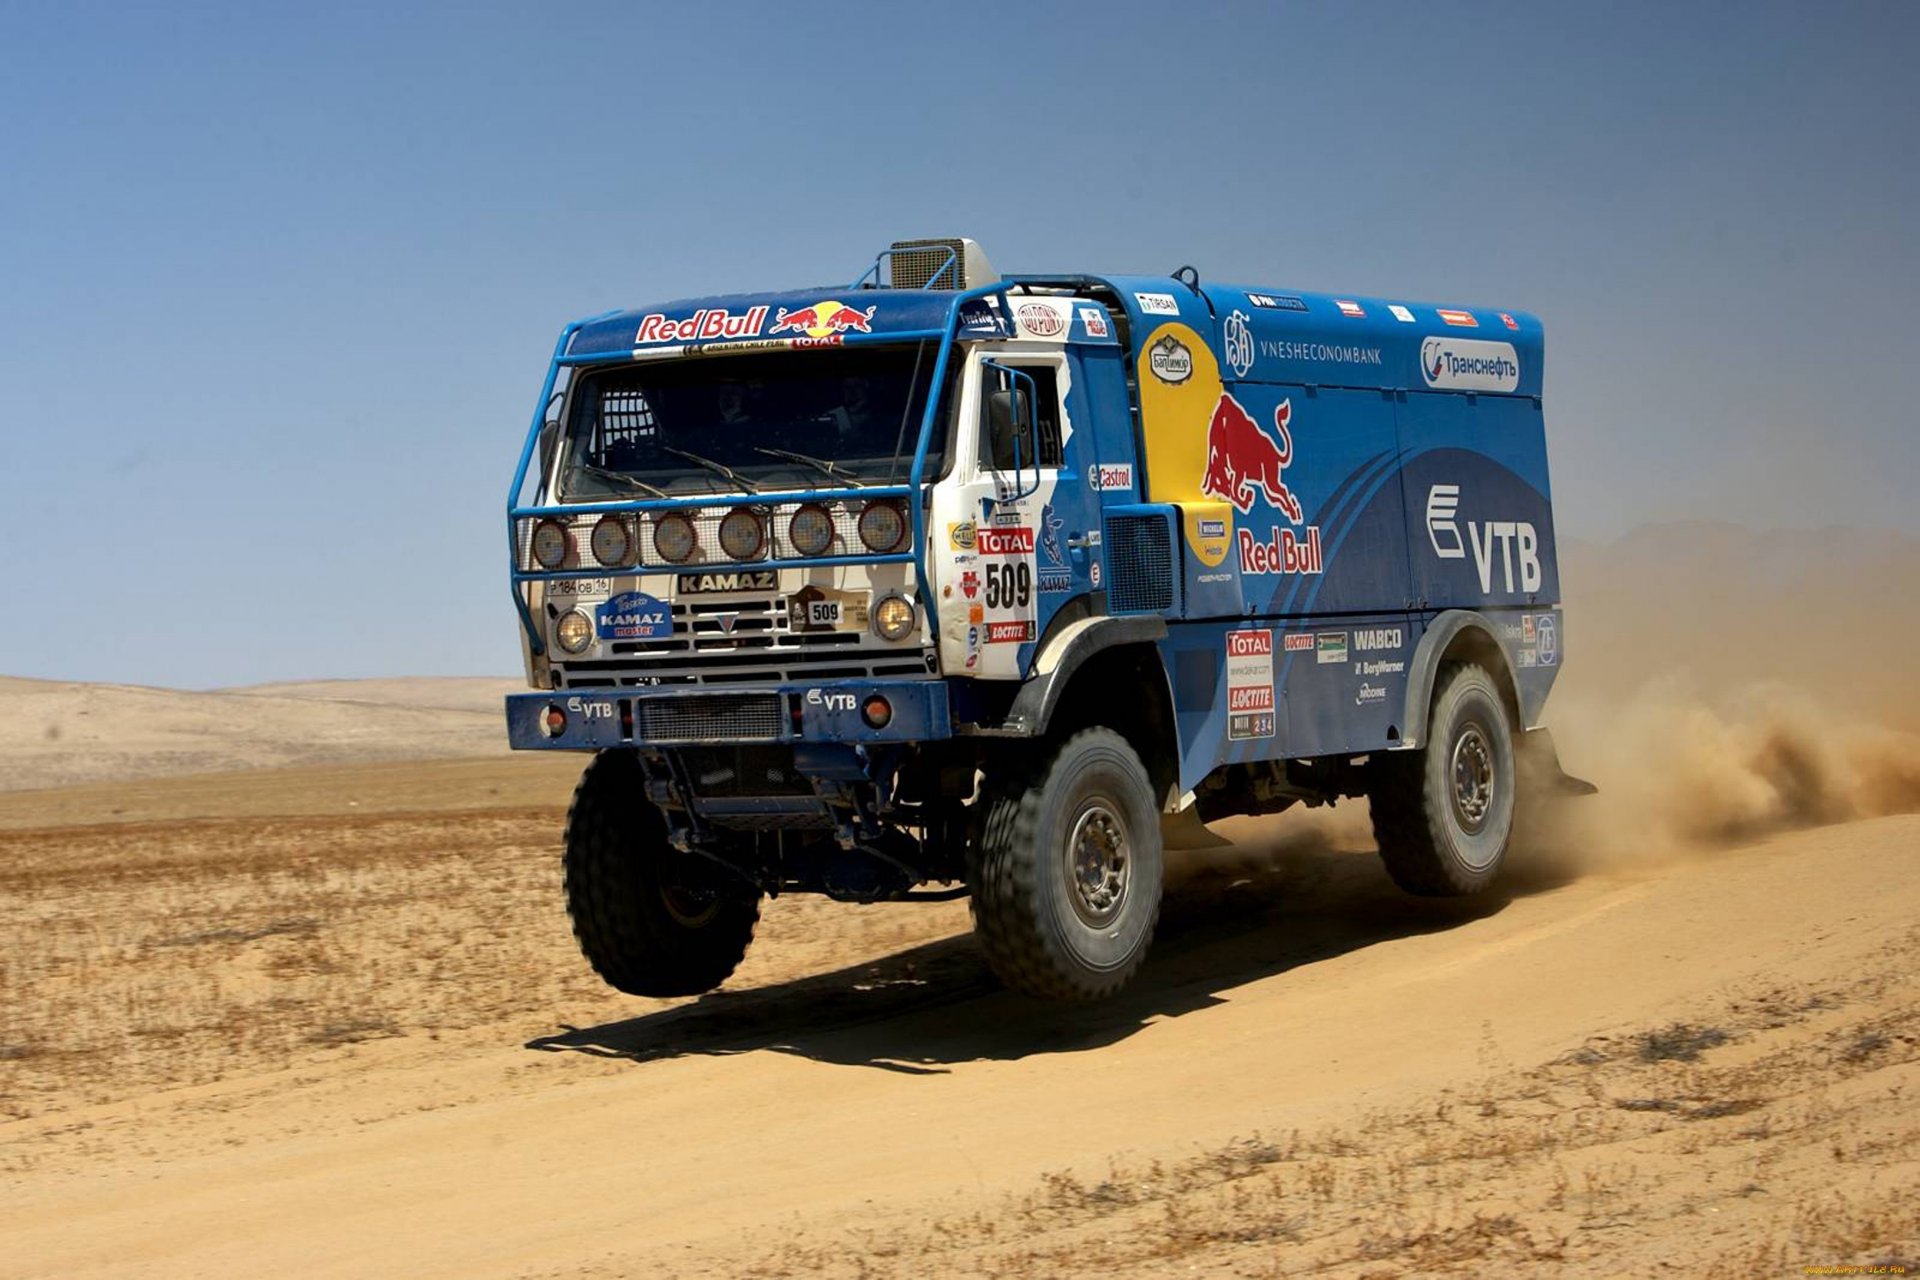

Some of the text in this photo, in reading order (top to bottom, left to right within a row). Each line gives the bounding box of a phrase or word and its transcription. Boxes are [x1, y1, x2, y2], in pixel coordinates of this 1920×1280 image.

[794, 336, 838, 348] TOTAL
[1260, 340, 1382, 365] VNESHECONOMBANK
[1443, 351, 1517, 378] Транснефть
[1100, 467, 1130, 487] Castrol
[978, 530, 1033, 552] TOTAL
[1467, 521, 1542, 594] VTB
[681, 572, 775, 593] KAMAZ
[985, 562, 1031, 609] 509
[600, 612, 665, 627] KAMAZ
[813, 603, 839, 621] 509
[614, 625, 655, 637] master
[992, 625, 1024, 639] LOCTITE
[1354, 629, 1402, 650] WABCO
[1229, 635, 1271, 654] TOTAL
[1363, 660, 1404, 677] BorgWarner
[823, 694, 857, 711] VTB
[1231, 688, 1272, 708] LOCTITE
[1359, 687, 1387, 699] MODINE
[582, 702, 613, 719] VTB
